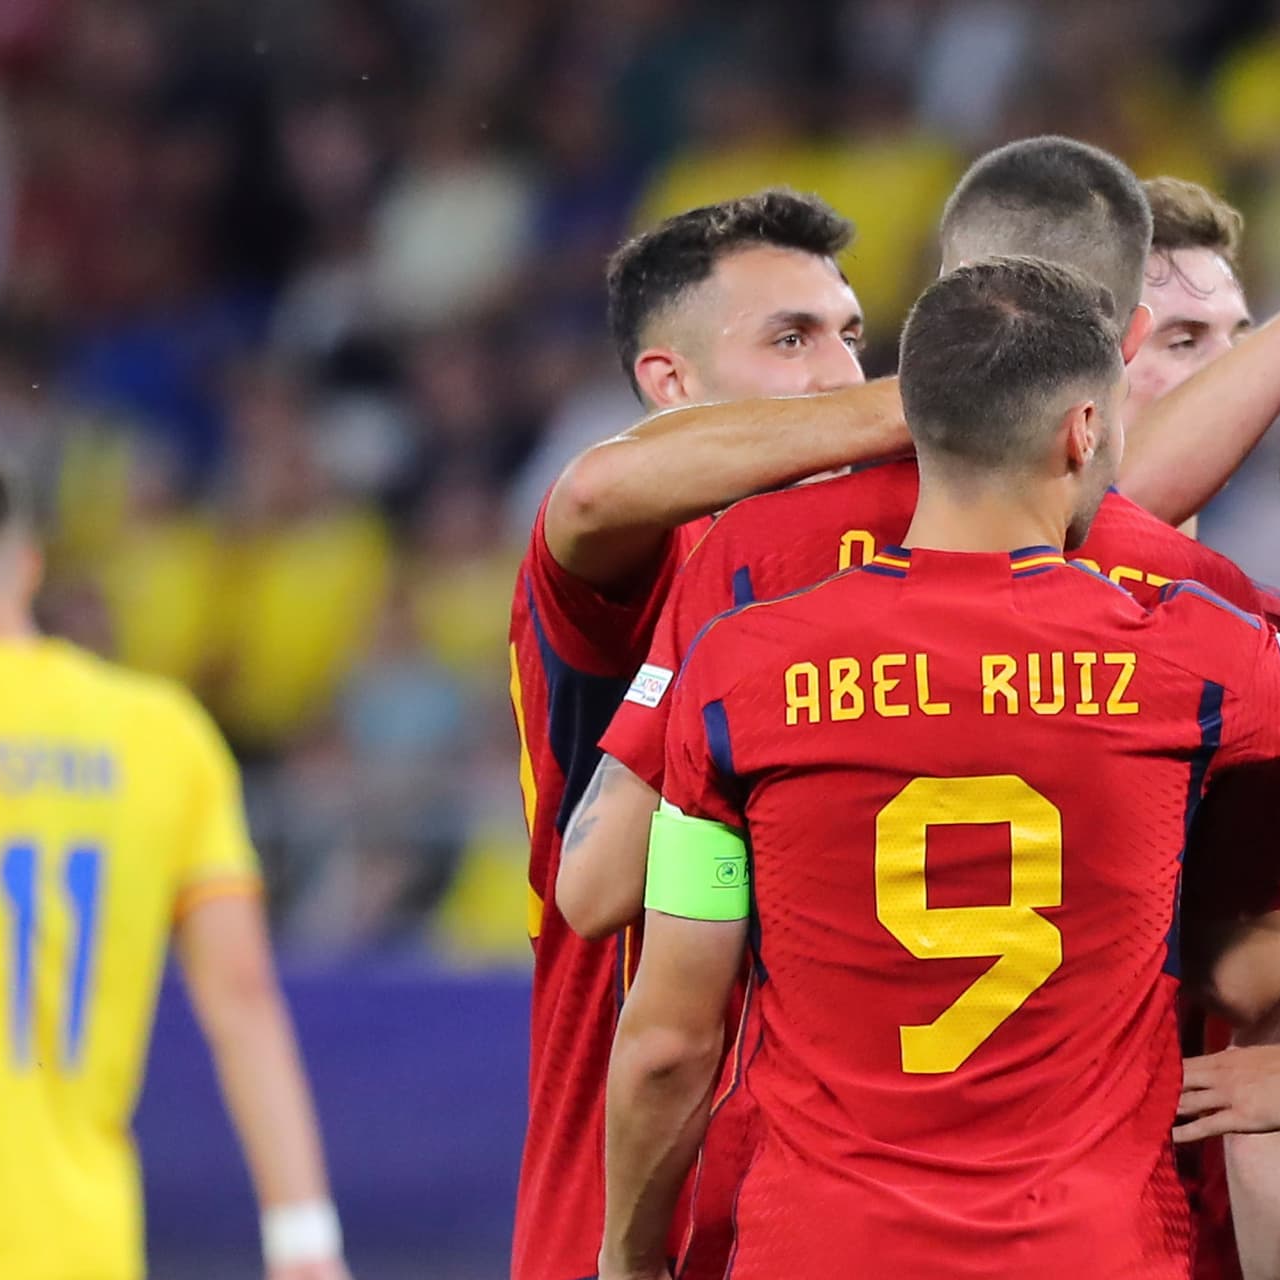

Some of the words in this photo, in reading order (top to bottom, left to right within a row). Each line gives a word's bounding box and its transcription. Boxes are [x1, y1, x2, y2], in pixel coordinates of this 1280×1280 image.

[784, 652, 952, 726] ABEL
[980, 651, 1141, 716] RUIZ
[874, 773, 1063, 1074] 9
